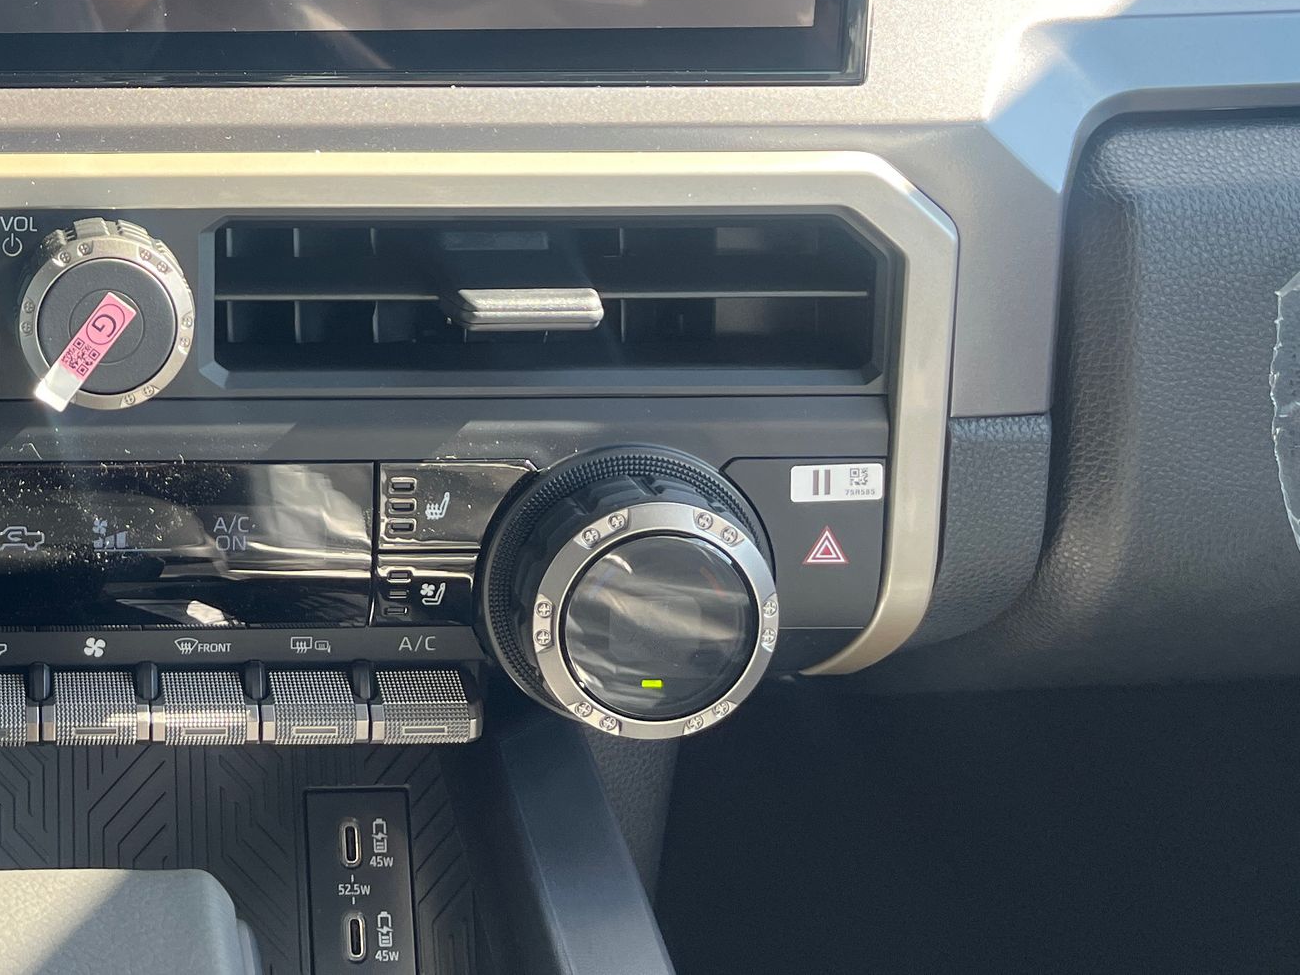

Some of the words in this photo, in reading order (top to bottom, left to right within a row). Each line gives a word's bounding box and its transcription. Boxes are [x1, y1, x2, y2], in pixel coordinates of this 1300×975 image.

[0, 216, 38, 232] VOL
[212, 516, 250, 533] A/C
[214, 535, 247, 551] ON
[198, 642, 232, 653] FRONT
[398, 635, 436, 651] A/C
[370, 857, 394, 867] 45W
[338, 884, 371, 896] 52.5W
[375, 950, 400, 961] 45W
